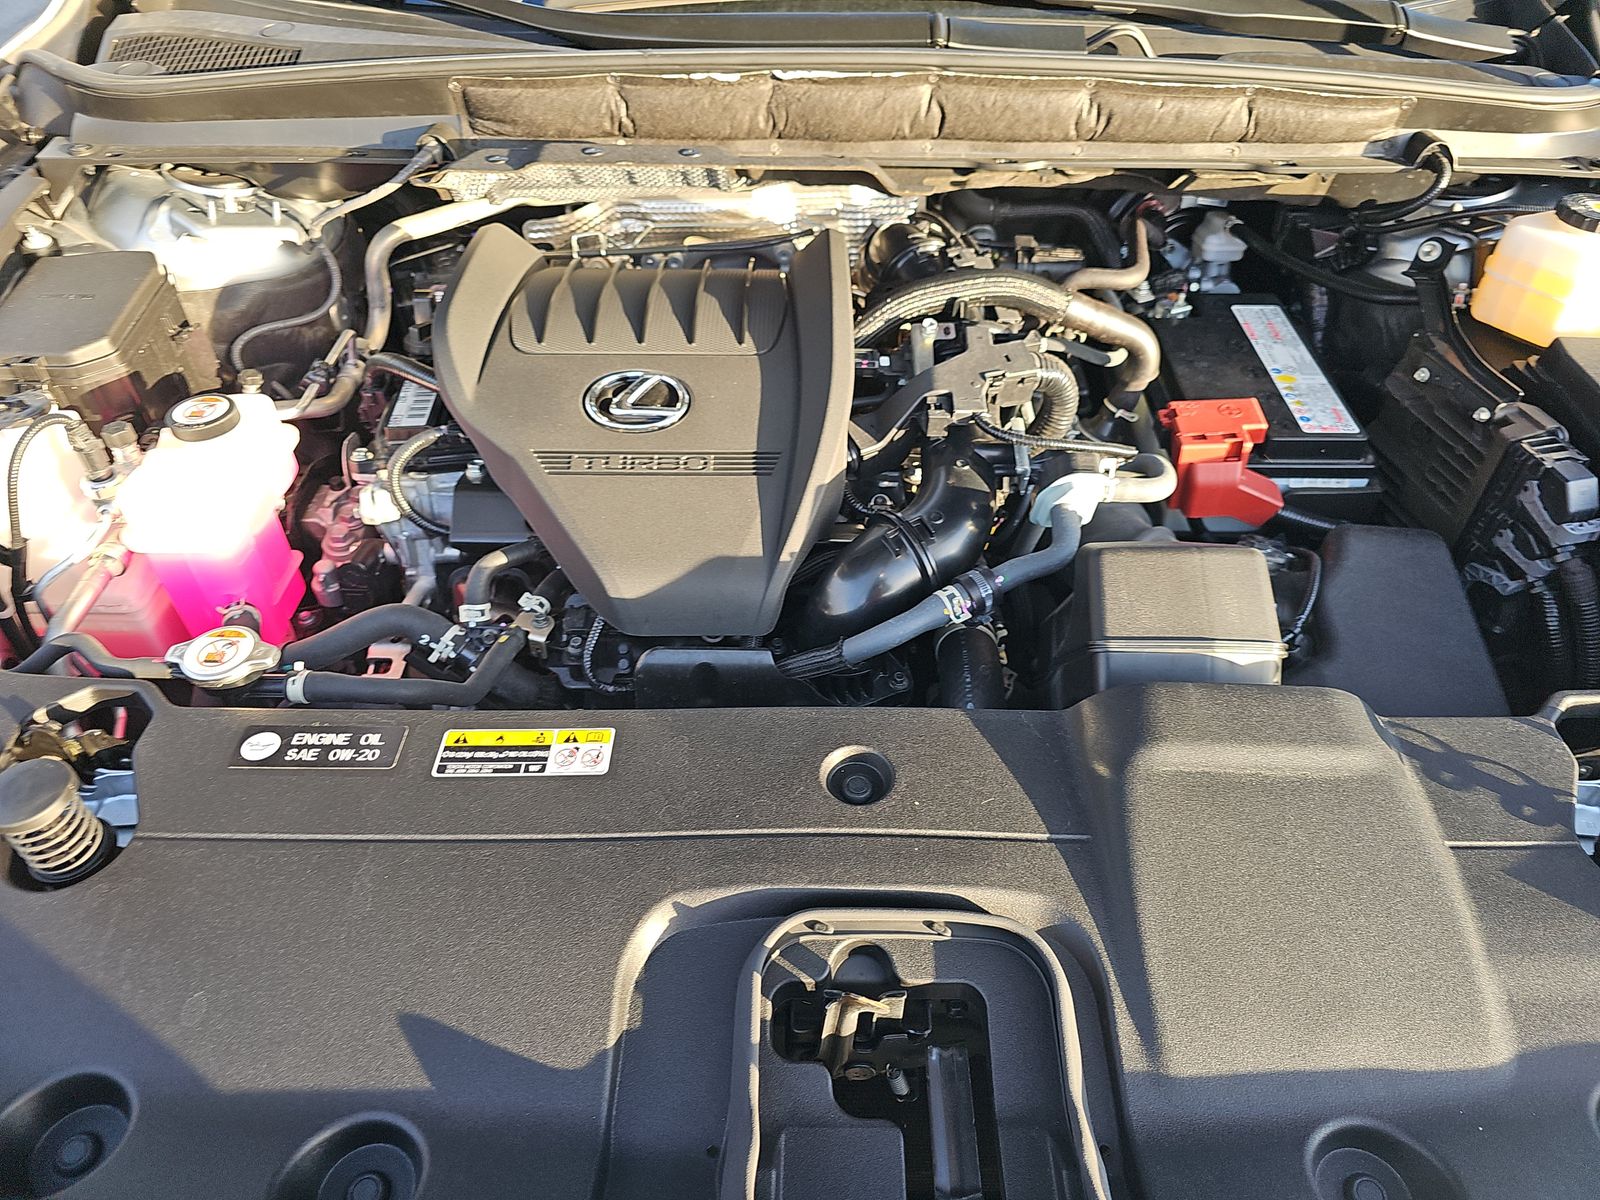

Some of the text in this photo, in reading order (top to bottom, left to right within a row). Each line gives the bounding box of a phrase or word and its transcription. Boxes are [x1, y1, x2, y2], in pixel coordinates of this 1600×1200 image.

[573, 454, 709, 471] TURBO
[290, 732, 386, 746] ENGINE OIL
[284, 748, 381, 762] SAE 0W-20
